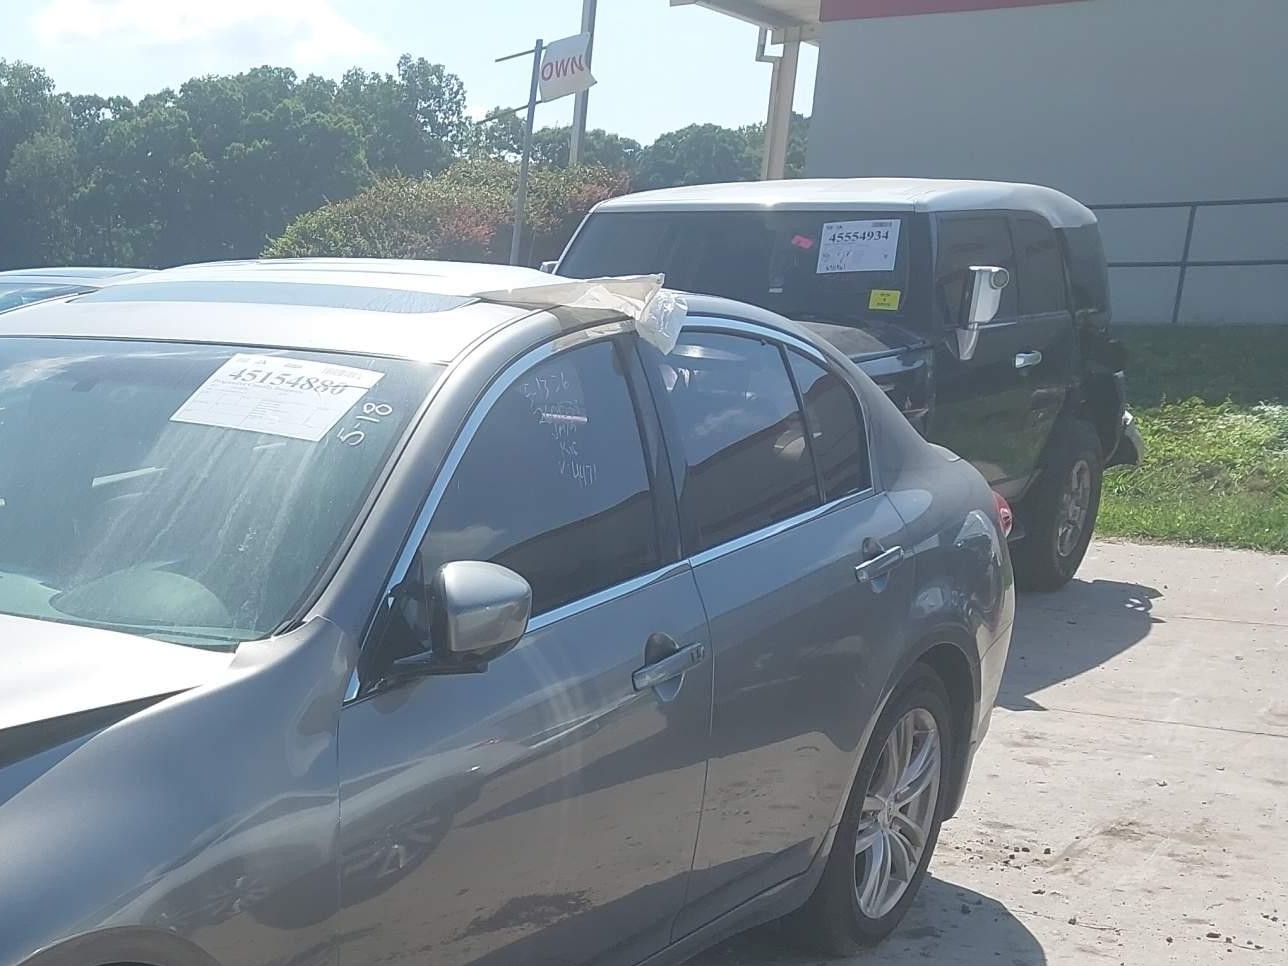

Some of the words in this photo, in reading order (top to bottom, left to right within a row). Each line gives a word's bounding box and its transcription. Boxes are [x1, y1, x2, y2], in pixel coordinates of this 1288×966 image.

[541, 54, 585, 81] OWN
[828, 230, 889, 243] 45554934
[228, 368, 349, 395] 45154880
[336, 402, 393, 446] 5-18
